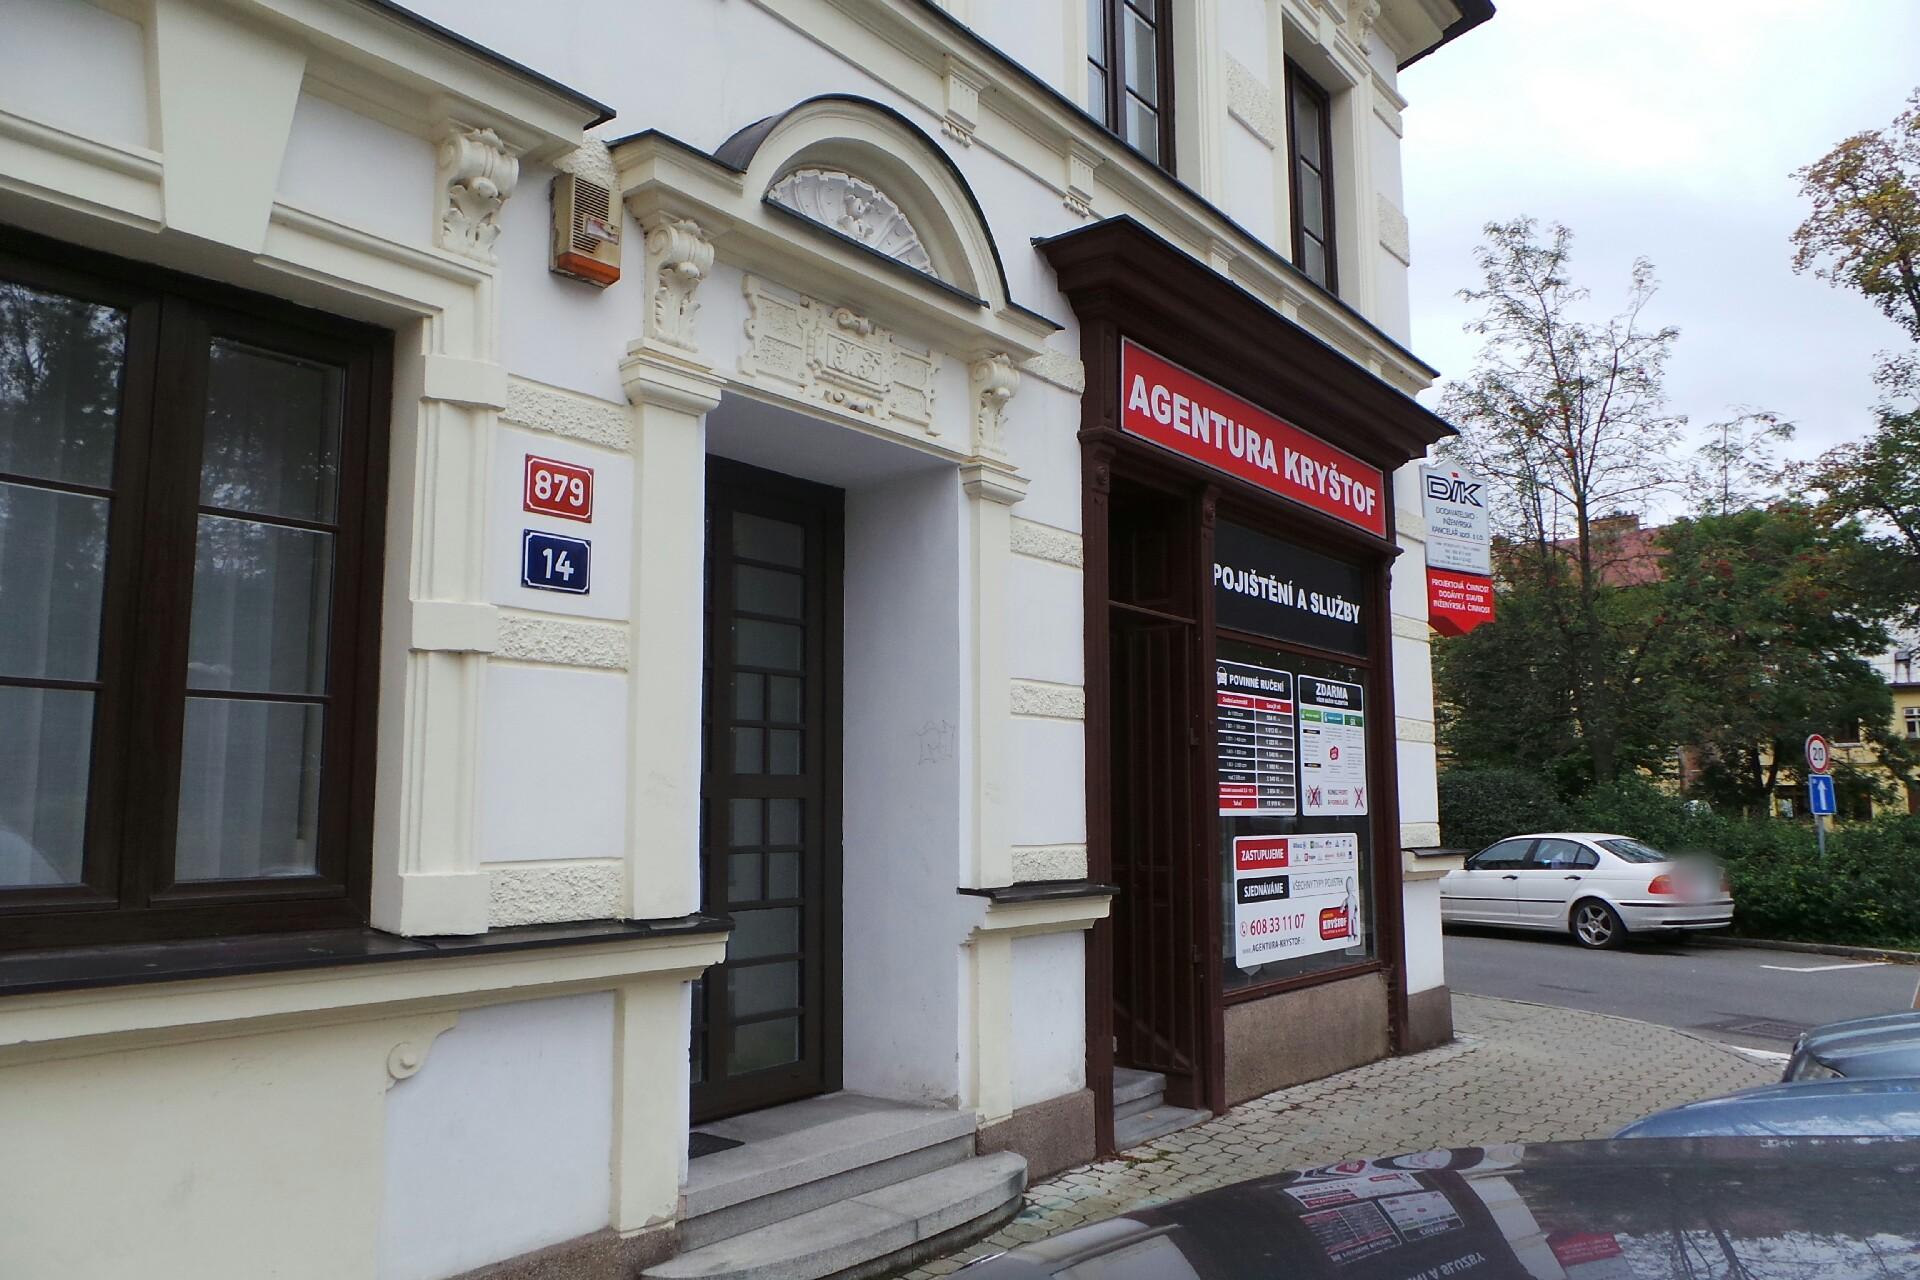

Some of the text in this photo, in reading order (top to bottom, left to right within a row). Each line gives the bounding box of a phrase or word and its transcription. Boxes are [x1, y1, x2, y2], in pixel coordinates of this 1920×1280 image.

[1128, 374, 1376, 516] AGENTURA KRYŠTOF
[534, 469, 584, 507] 879
[543, 548, 574, 581] 14
[1213, 563, 1361, 624] POJIŠTĚNÍ A SLUŽBY
[1229, 674, 1285, 692] POVINNÉ RUČENÍ
[1315, 682, 1349, 700] ZDARMA
[1813, 747, 1824, 761] 20
[1241, 848, 1284, 862] ZASTUPUJEME
[1243, 881, 1284, 898] SJEDNÁVÁME
[1250, 914, 1305, 936] 608 33 11 07
